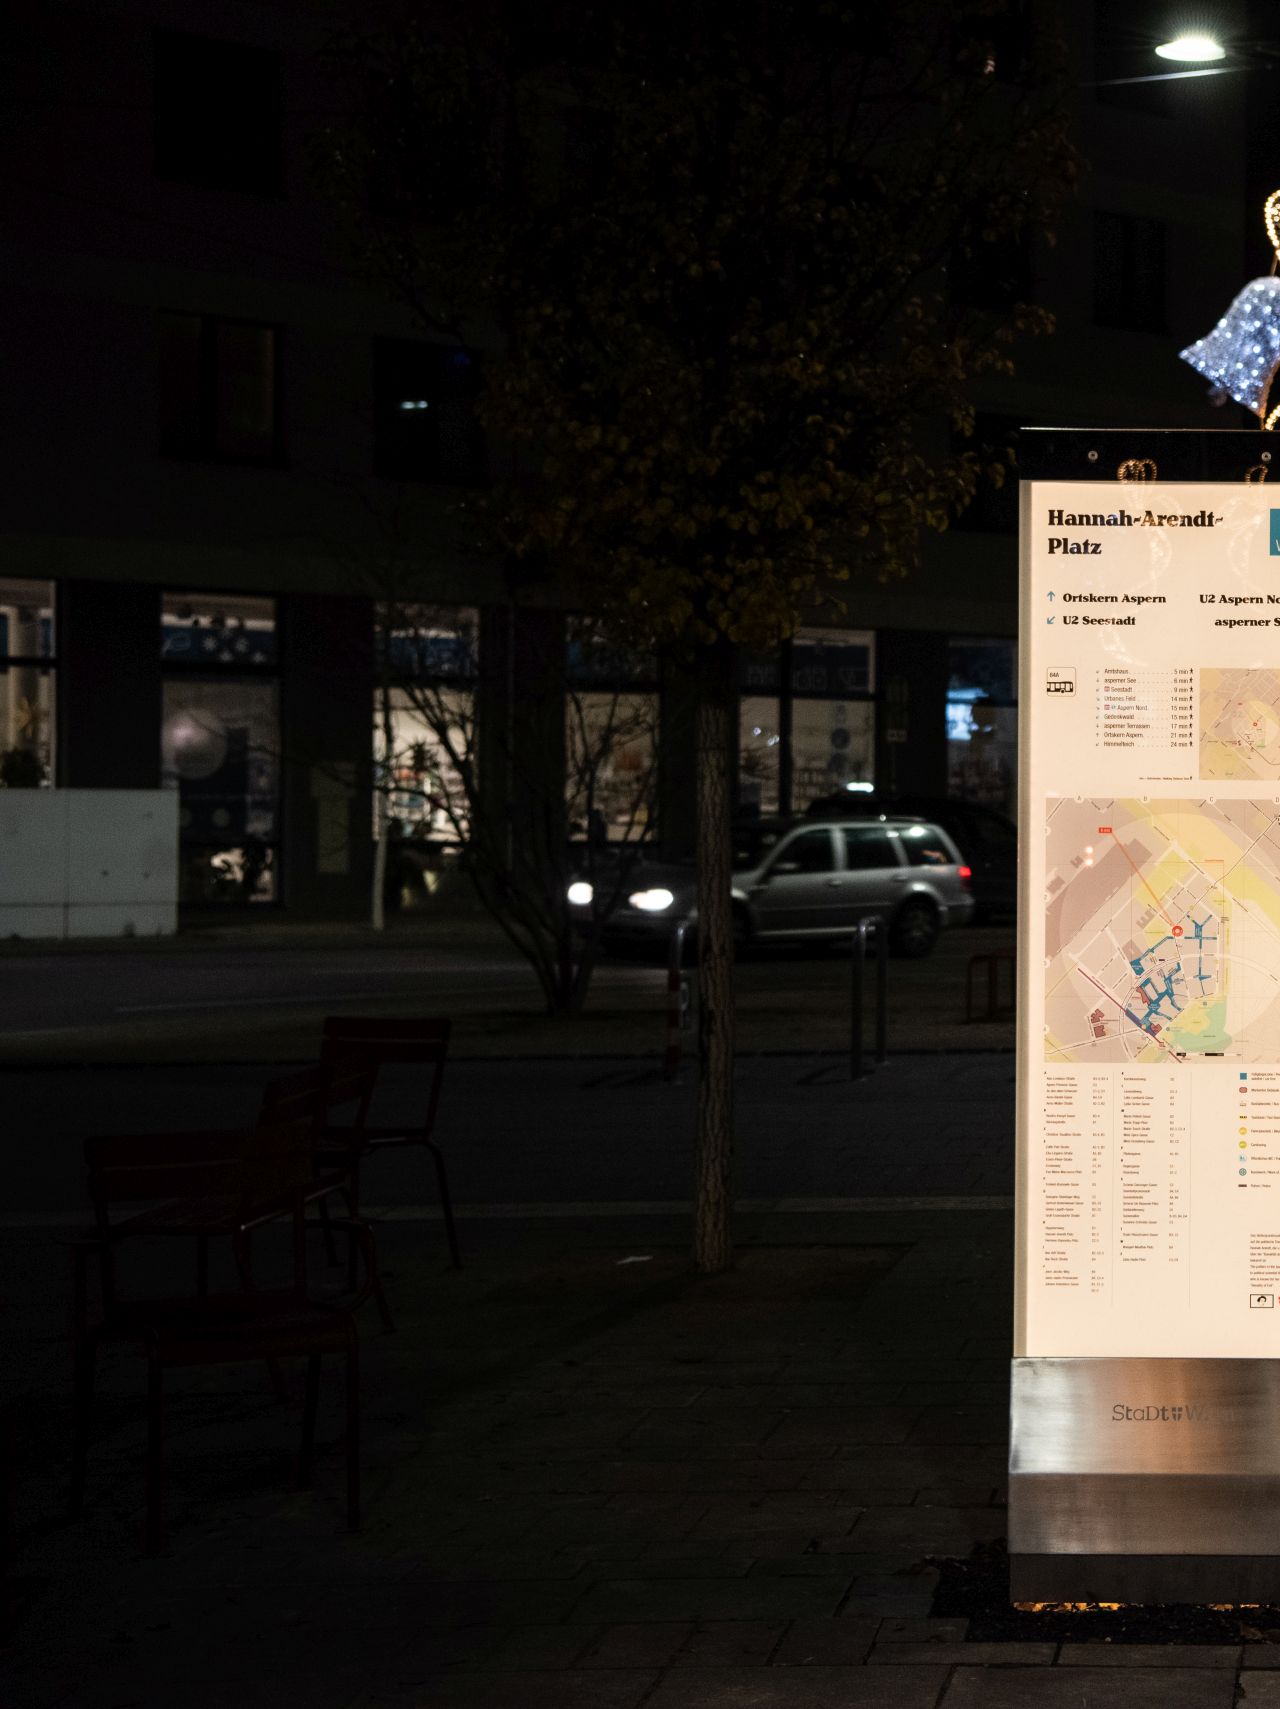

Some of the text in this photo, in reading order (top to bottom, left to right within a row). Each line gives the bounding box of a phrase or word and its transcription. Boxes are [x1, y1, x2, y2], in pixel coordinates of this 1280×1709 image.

[1047, 509, 1224, 528] Hannah-Arendt-
[1047, 537, 1103, 555] Platz
[1062, 592, 1167, 605] Ortskern Aspern
[1199, 593, 1216, 604] U2
[1218, 594, 1264, 606] Aspern
[1062, 615, 1136, 626] U2 Seestadt
[1214, 617, 1272, 629] asperner
[1104, 677, 1126, 685] asperner
[1117, 704, 1135, 713] Aspern
[1135, 704, 1148, 712] Nord
[1104, 722, 1126, 730] asperner
[1125, 731, 1143, 739] Aspern
